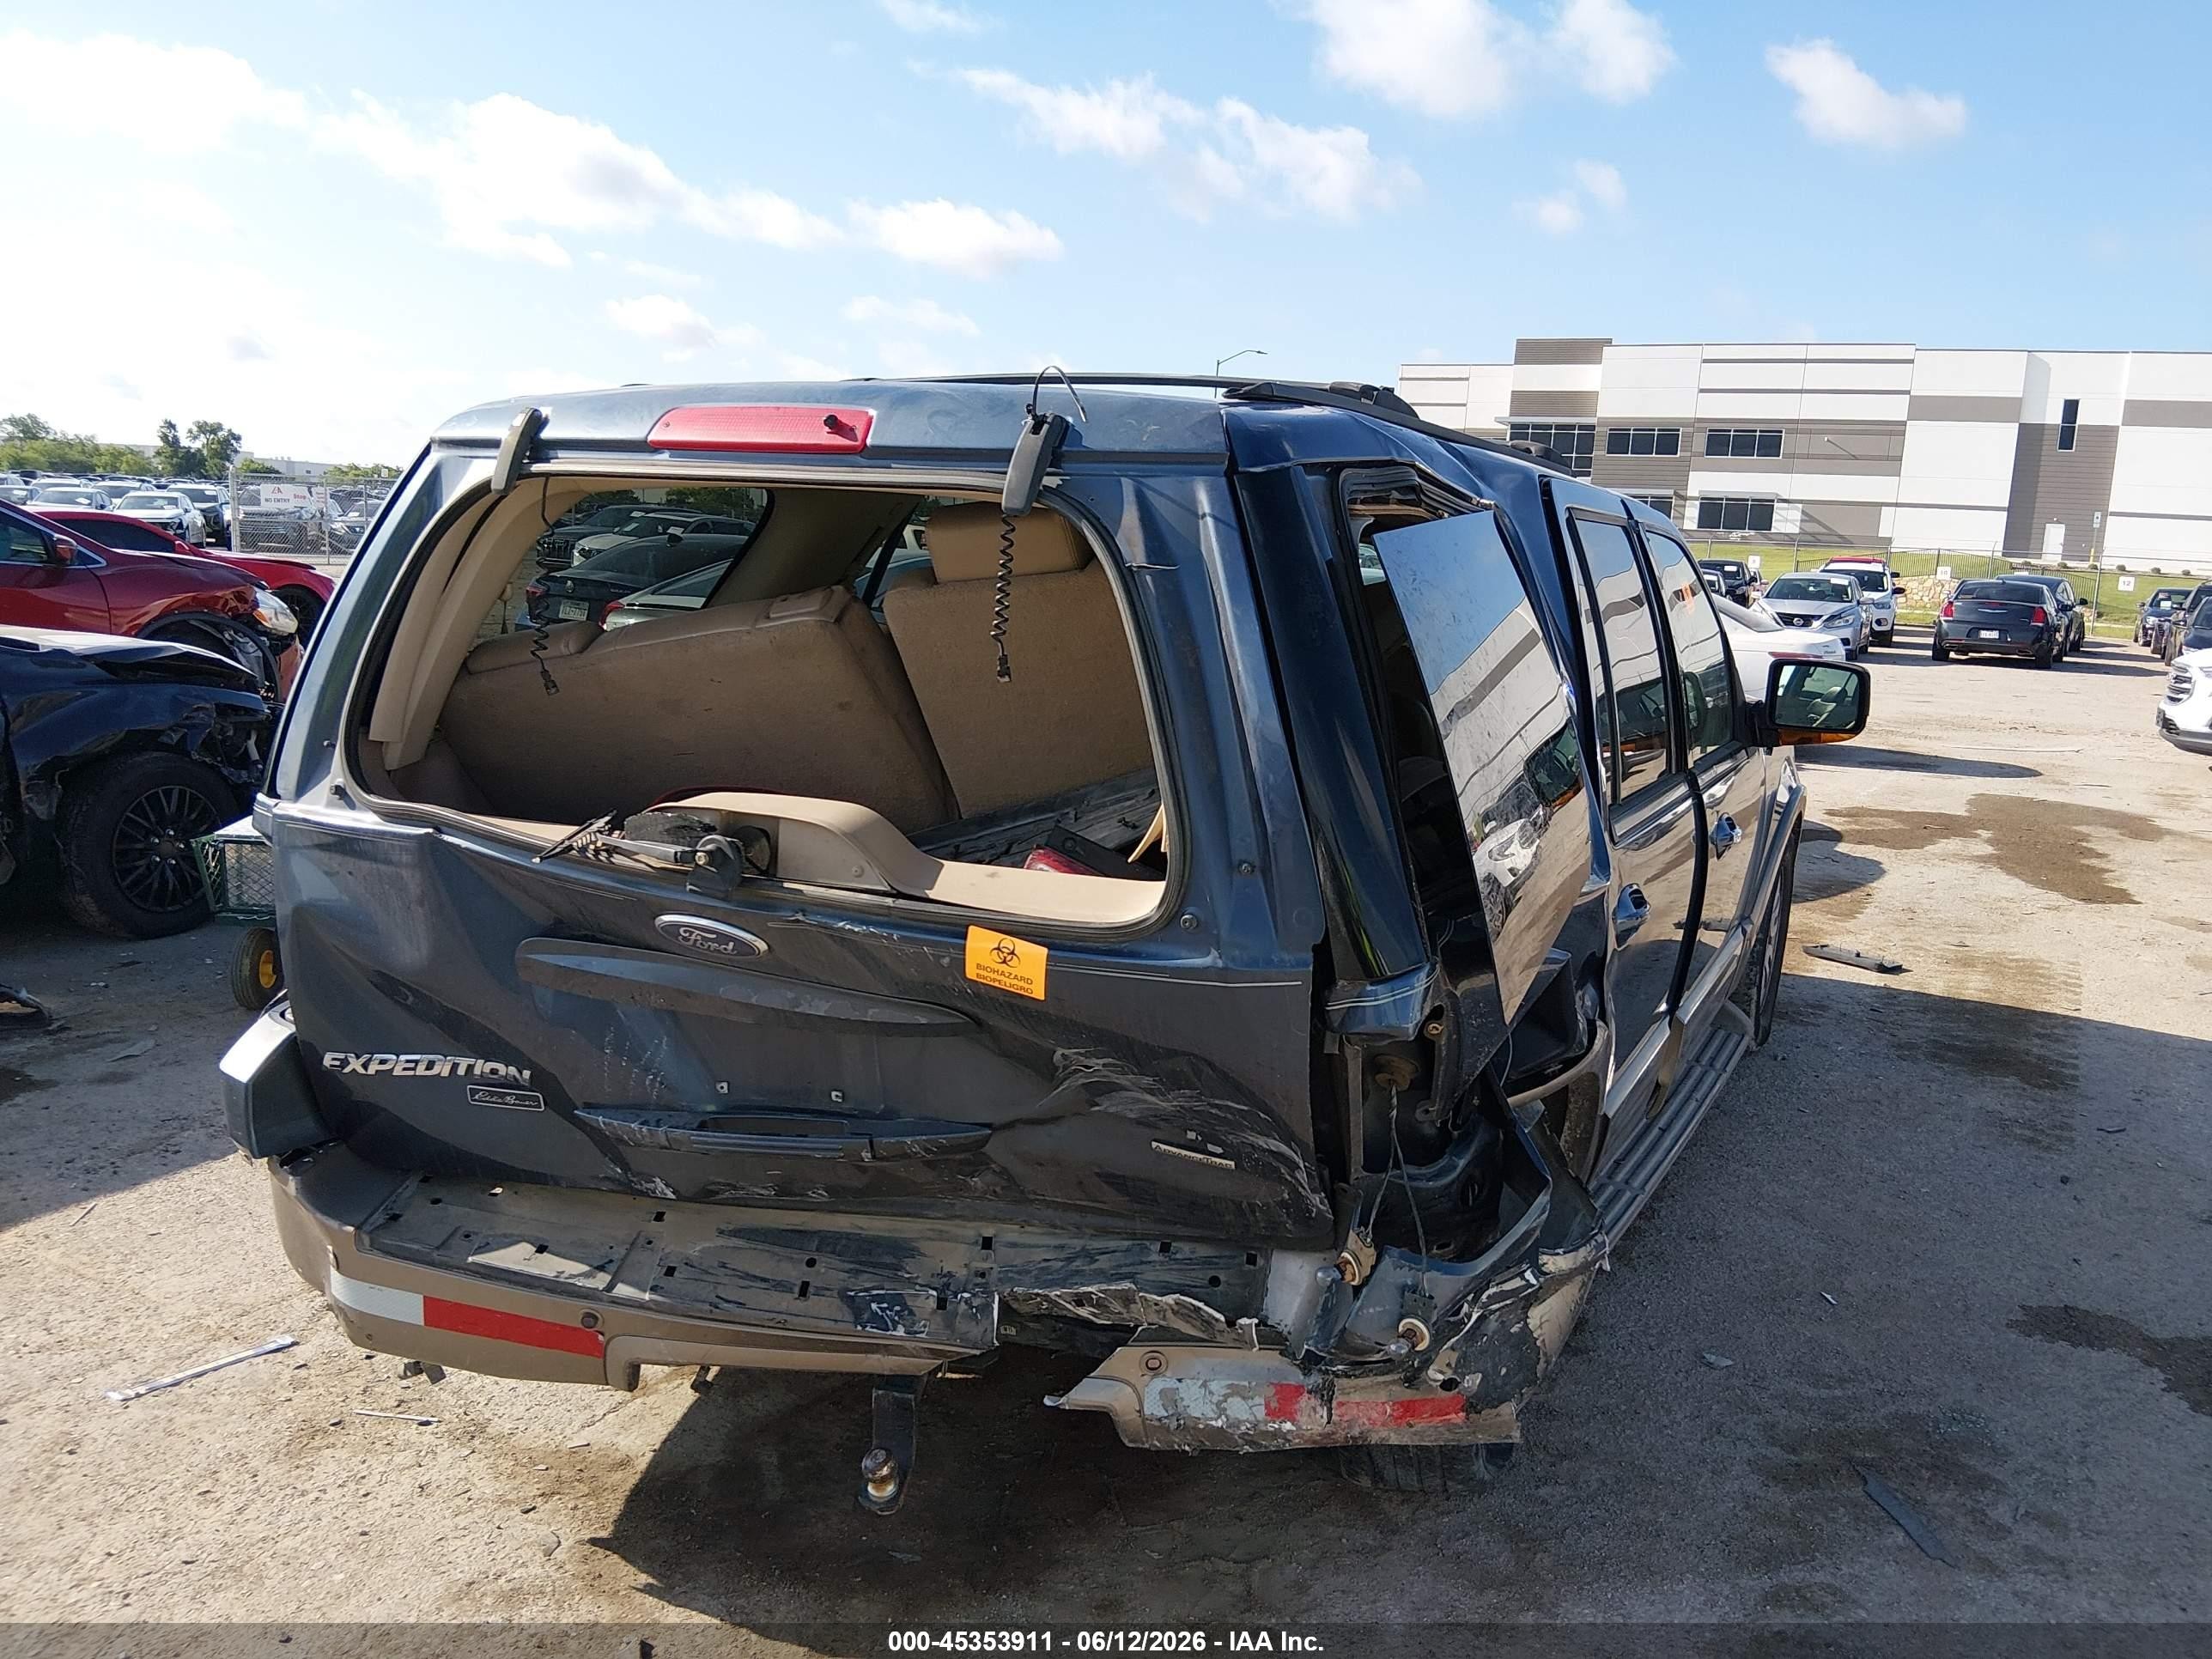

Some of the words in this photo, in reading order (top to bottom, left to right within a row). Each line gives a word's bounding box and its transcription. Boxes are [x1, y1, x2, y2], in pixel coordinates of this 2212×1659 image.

[678, 927, 737, 956] Ford
[975, 963, 1034, 986] BIOHAZARD
[975, 972, 1034, 995] BIOPELIGRO
[322, 1052, 532, 1085] EXPEDITION
